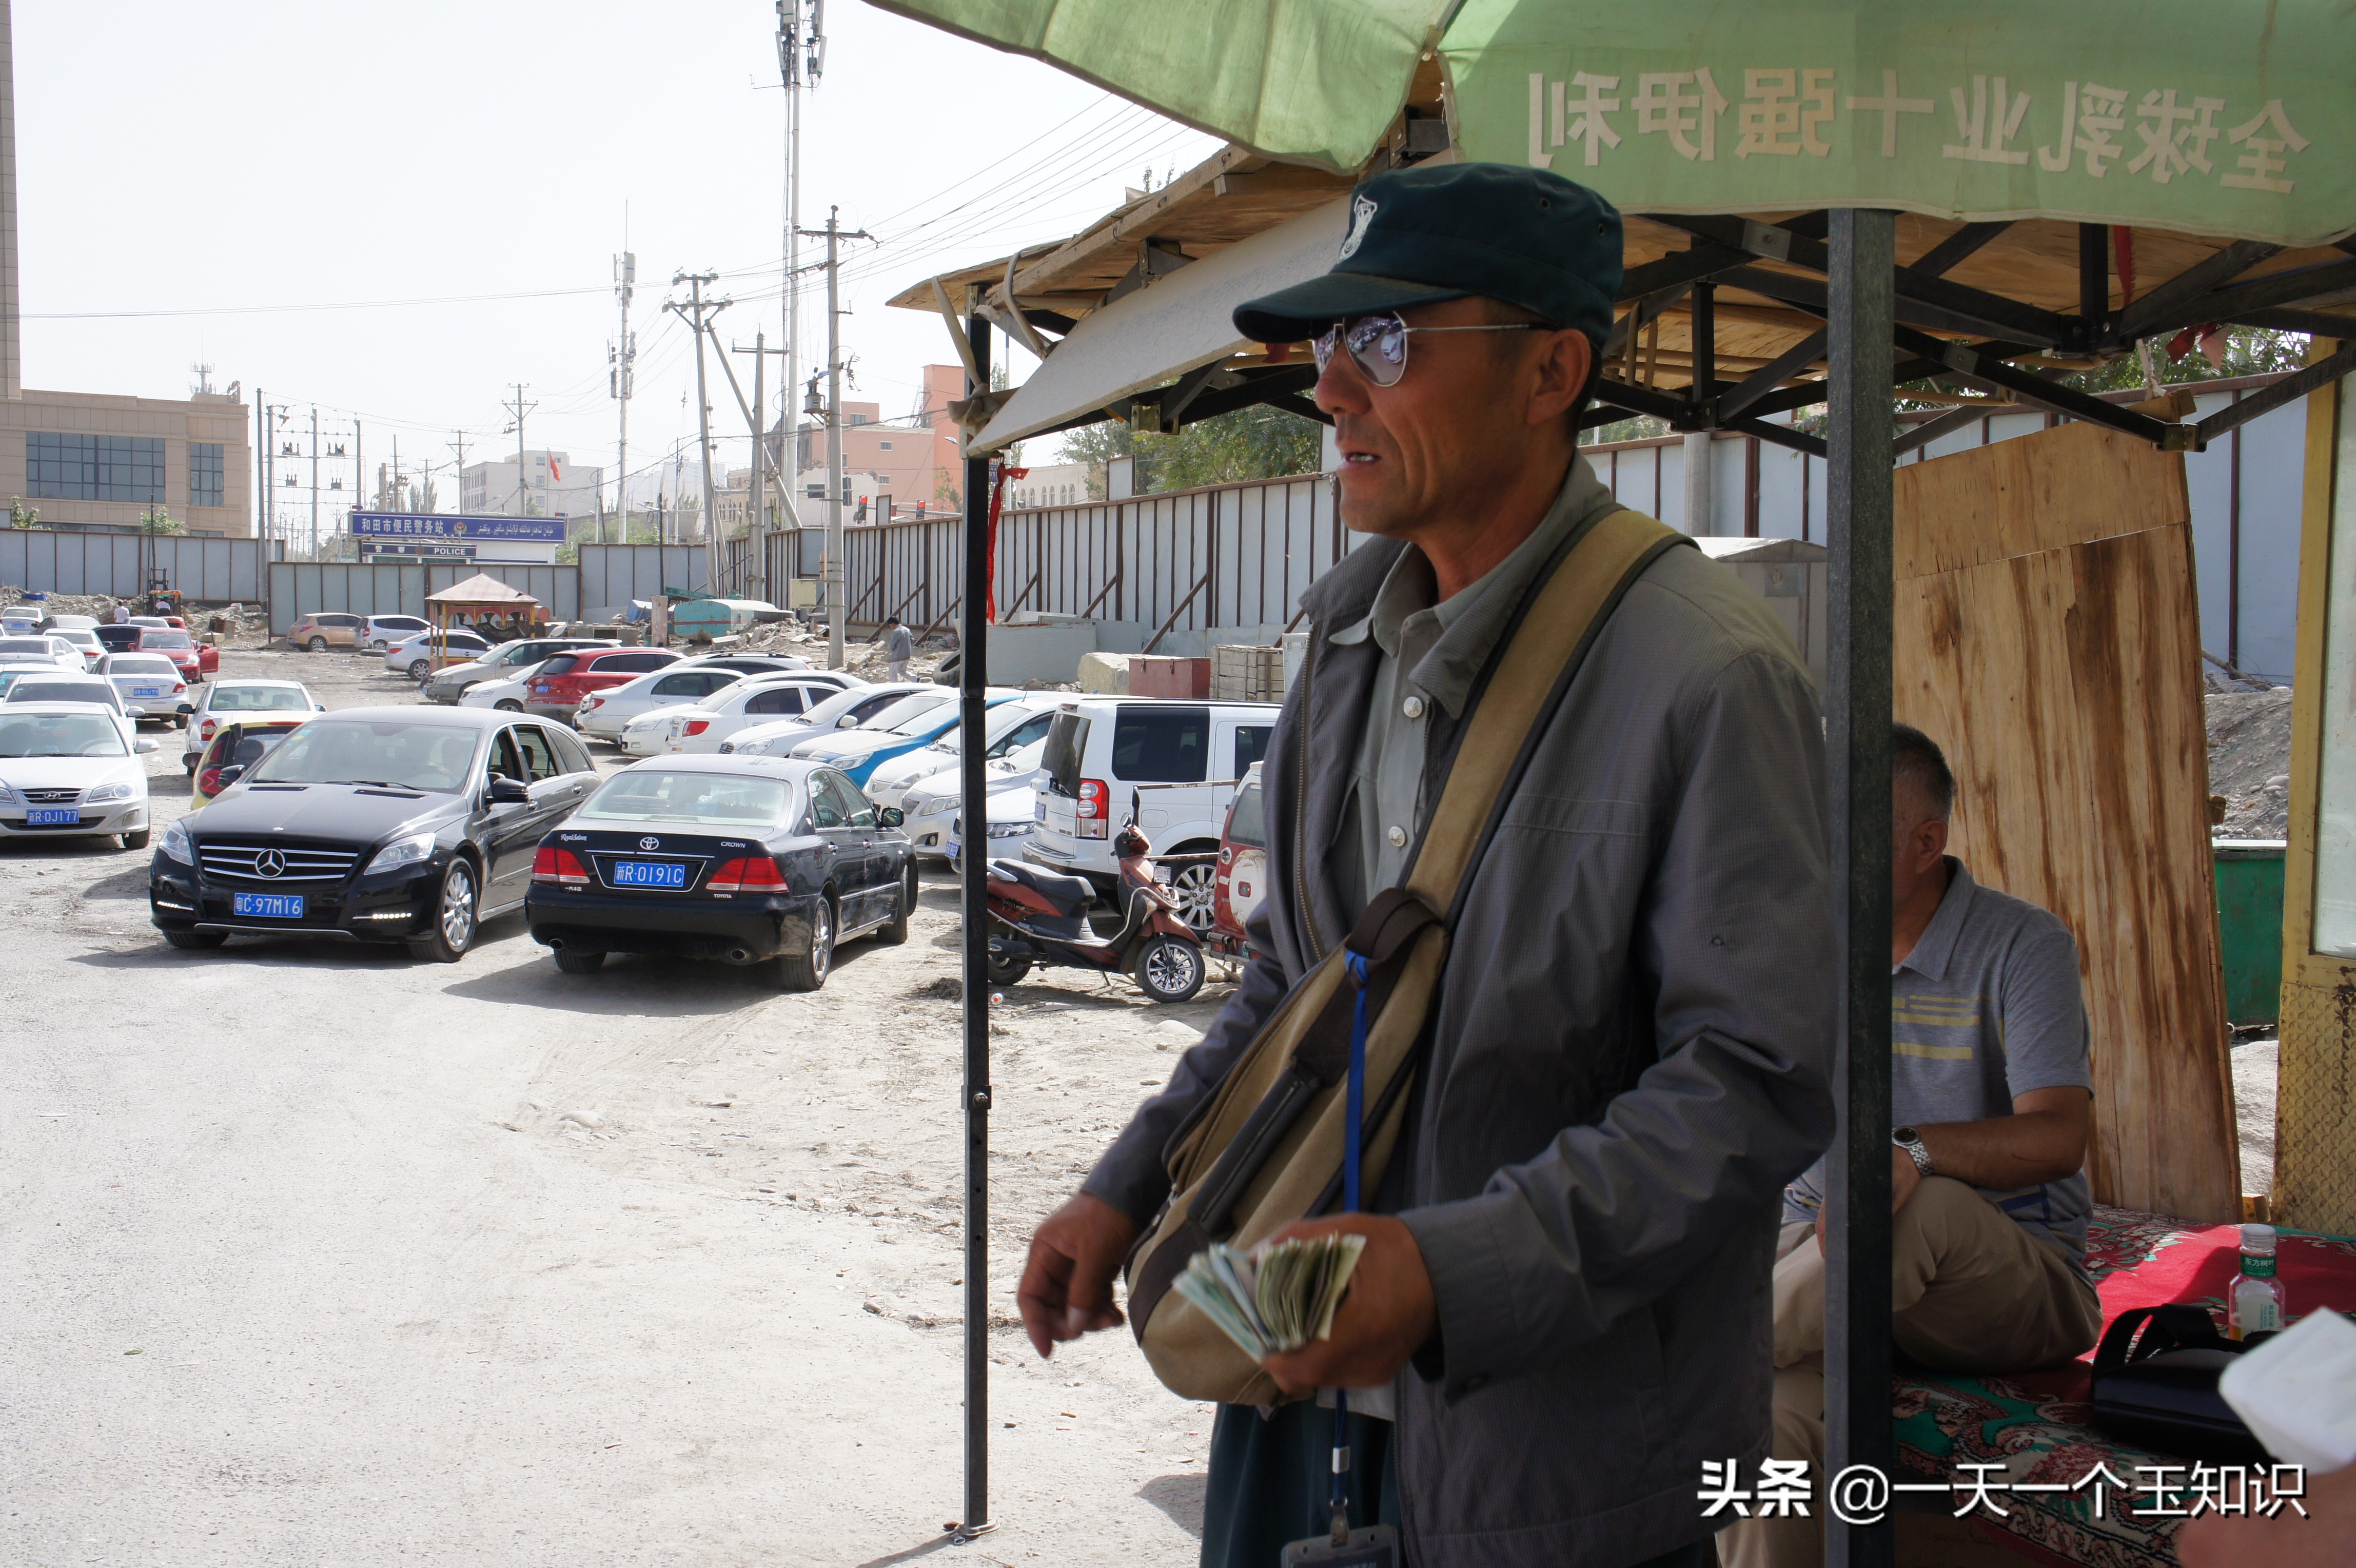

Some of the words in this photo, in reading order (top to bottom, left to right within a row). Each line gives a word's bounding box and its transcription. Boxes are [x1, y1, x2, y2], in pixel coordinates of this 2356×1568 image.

[362, 518, 444, 534] 和田市便民警务站
[2244, 1257, 2274, 1267] 东方树叶
